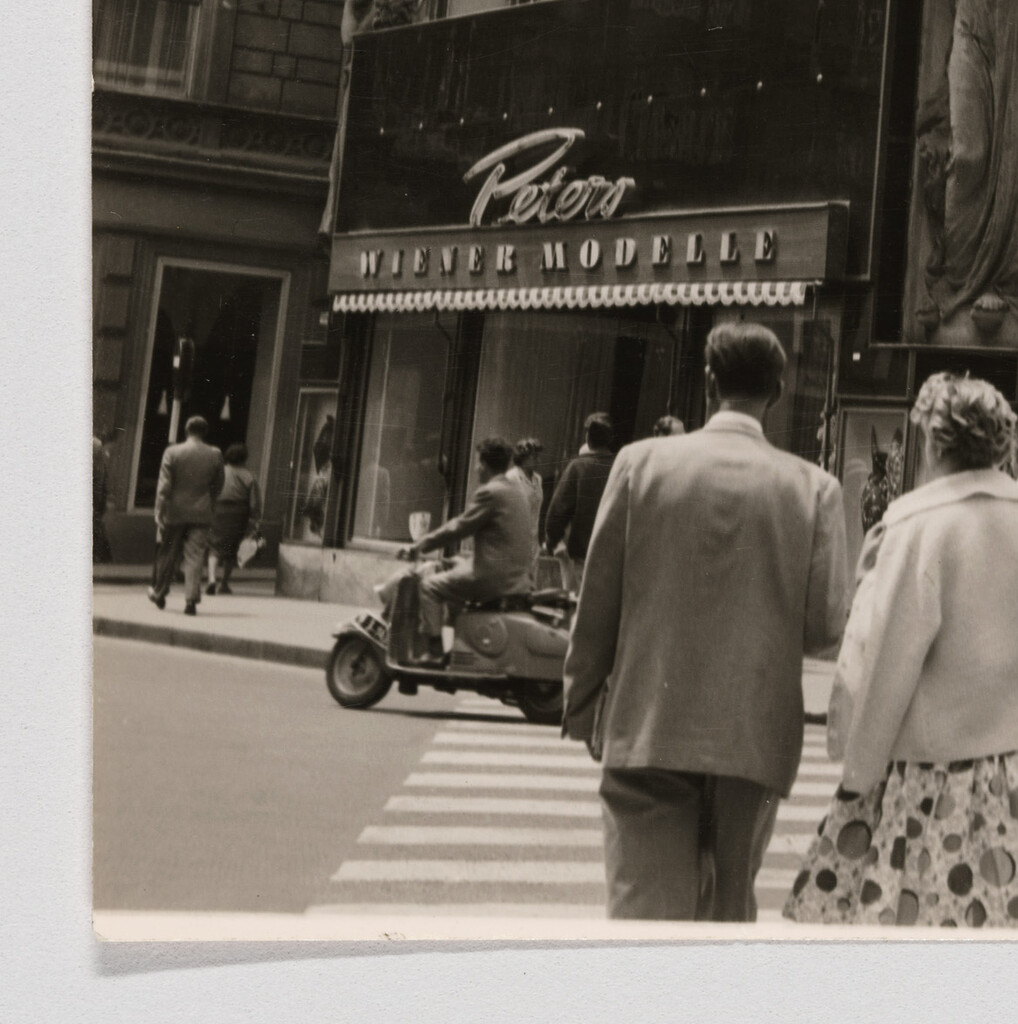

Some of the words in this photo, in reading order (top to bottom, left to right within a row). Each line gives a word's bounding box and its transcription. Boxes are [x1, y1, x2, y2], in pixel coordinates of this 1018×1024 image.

[463, 127, 636, 227] Peters
[359, 243, 518, 276] WIENER
[540, 229, 776, 272] MODELLE
